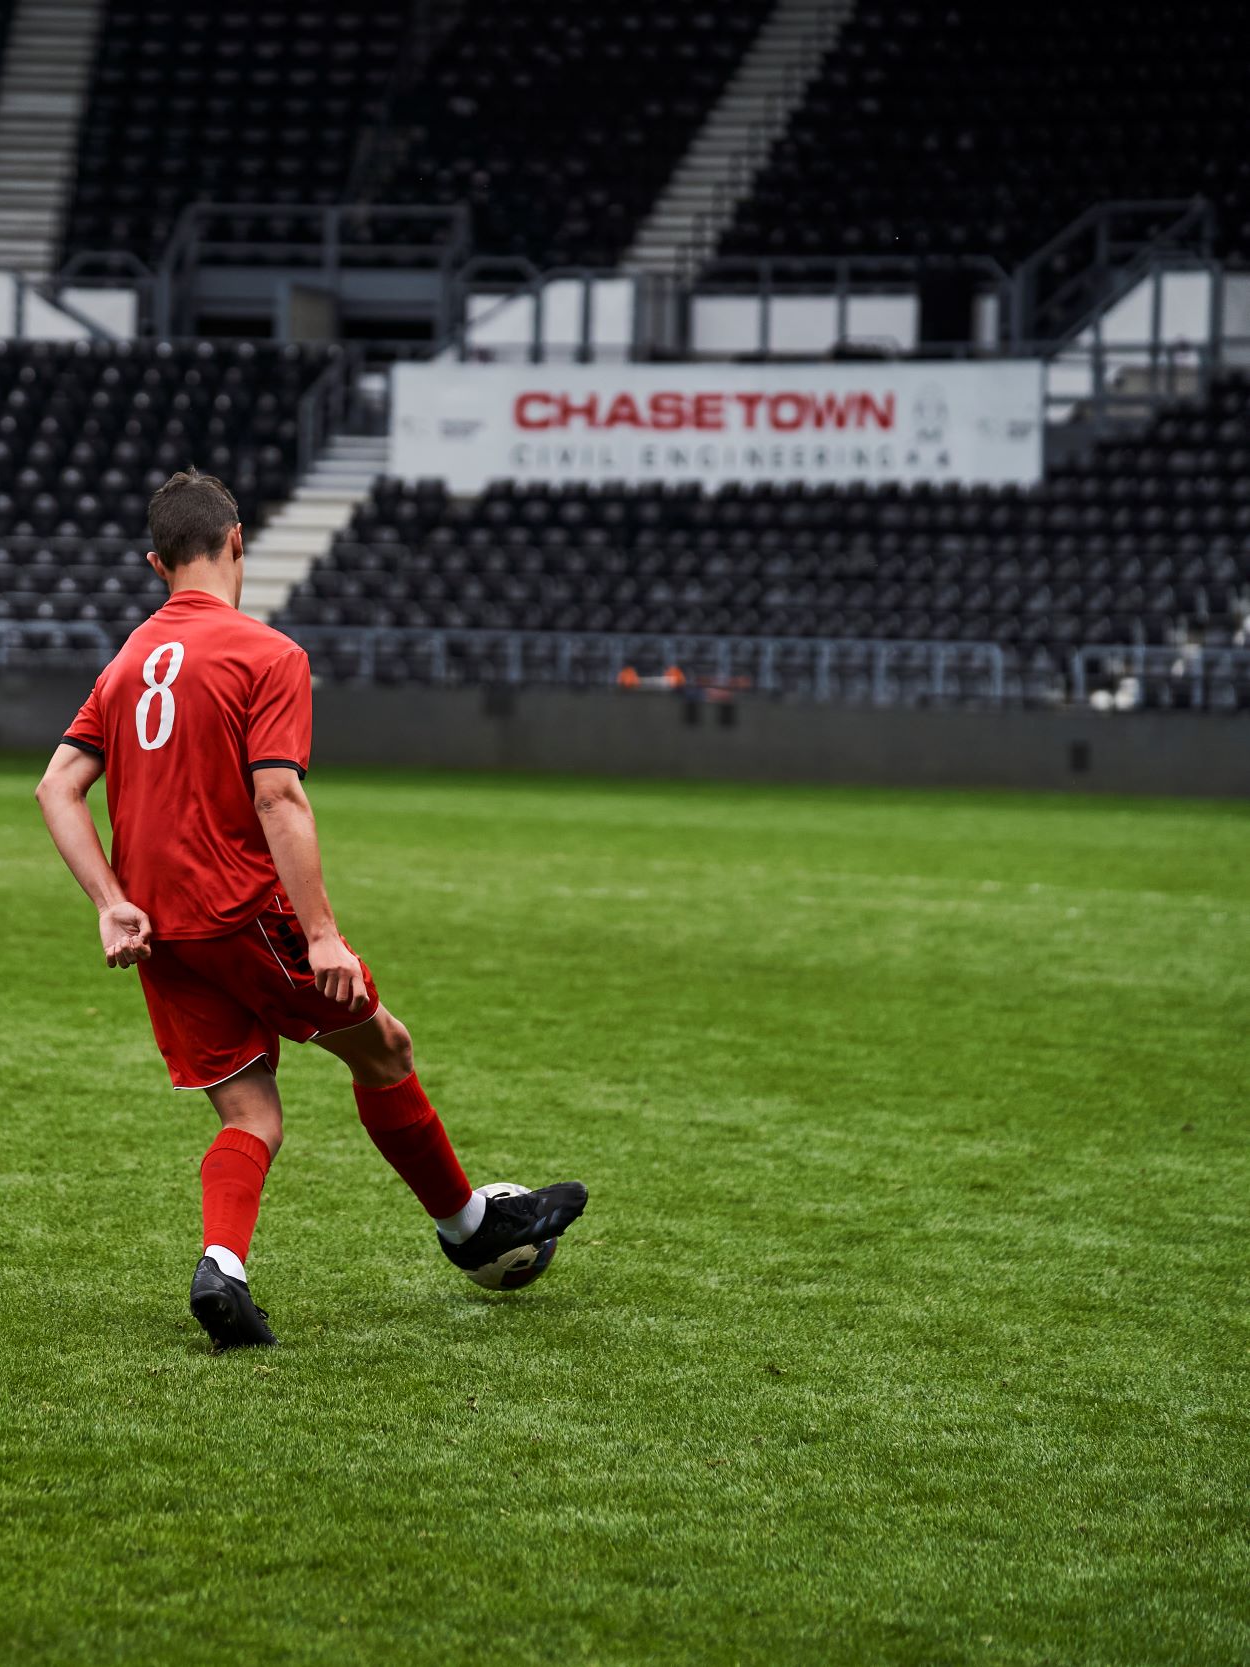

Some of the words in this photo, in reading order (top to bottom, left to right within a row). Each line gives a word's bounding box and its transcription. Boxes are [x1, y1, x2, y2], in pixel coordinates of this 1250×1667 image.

[513, 391, 897, 432] CHASETOWN
[510, 443, 616, 471] CIVIL
[639, 443, 895, 471] ENGINEERING
[136, 641, 185, 750] 8
